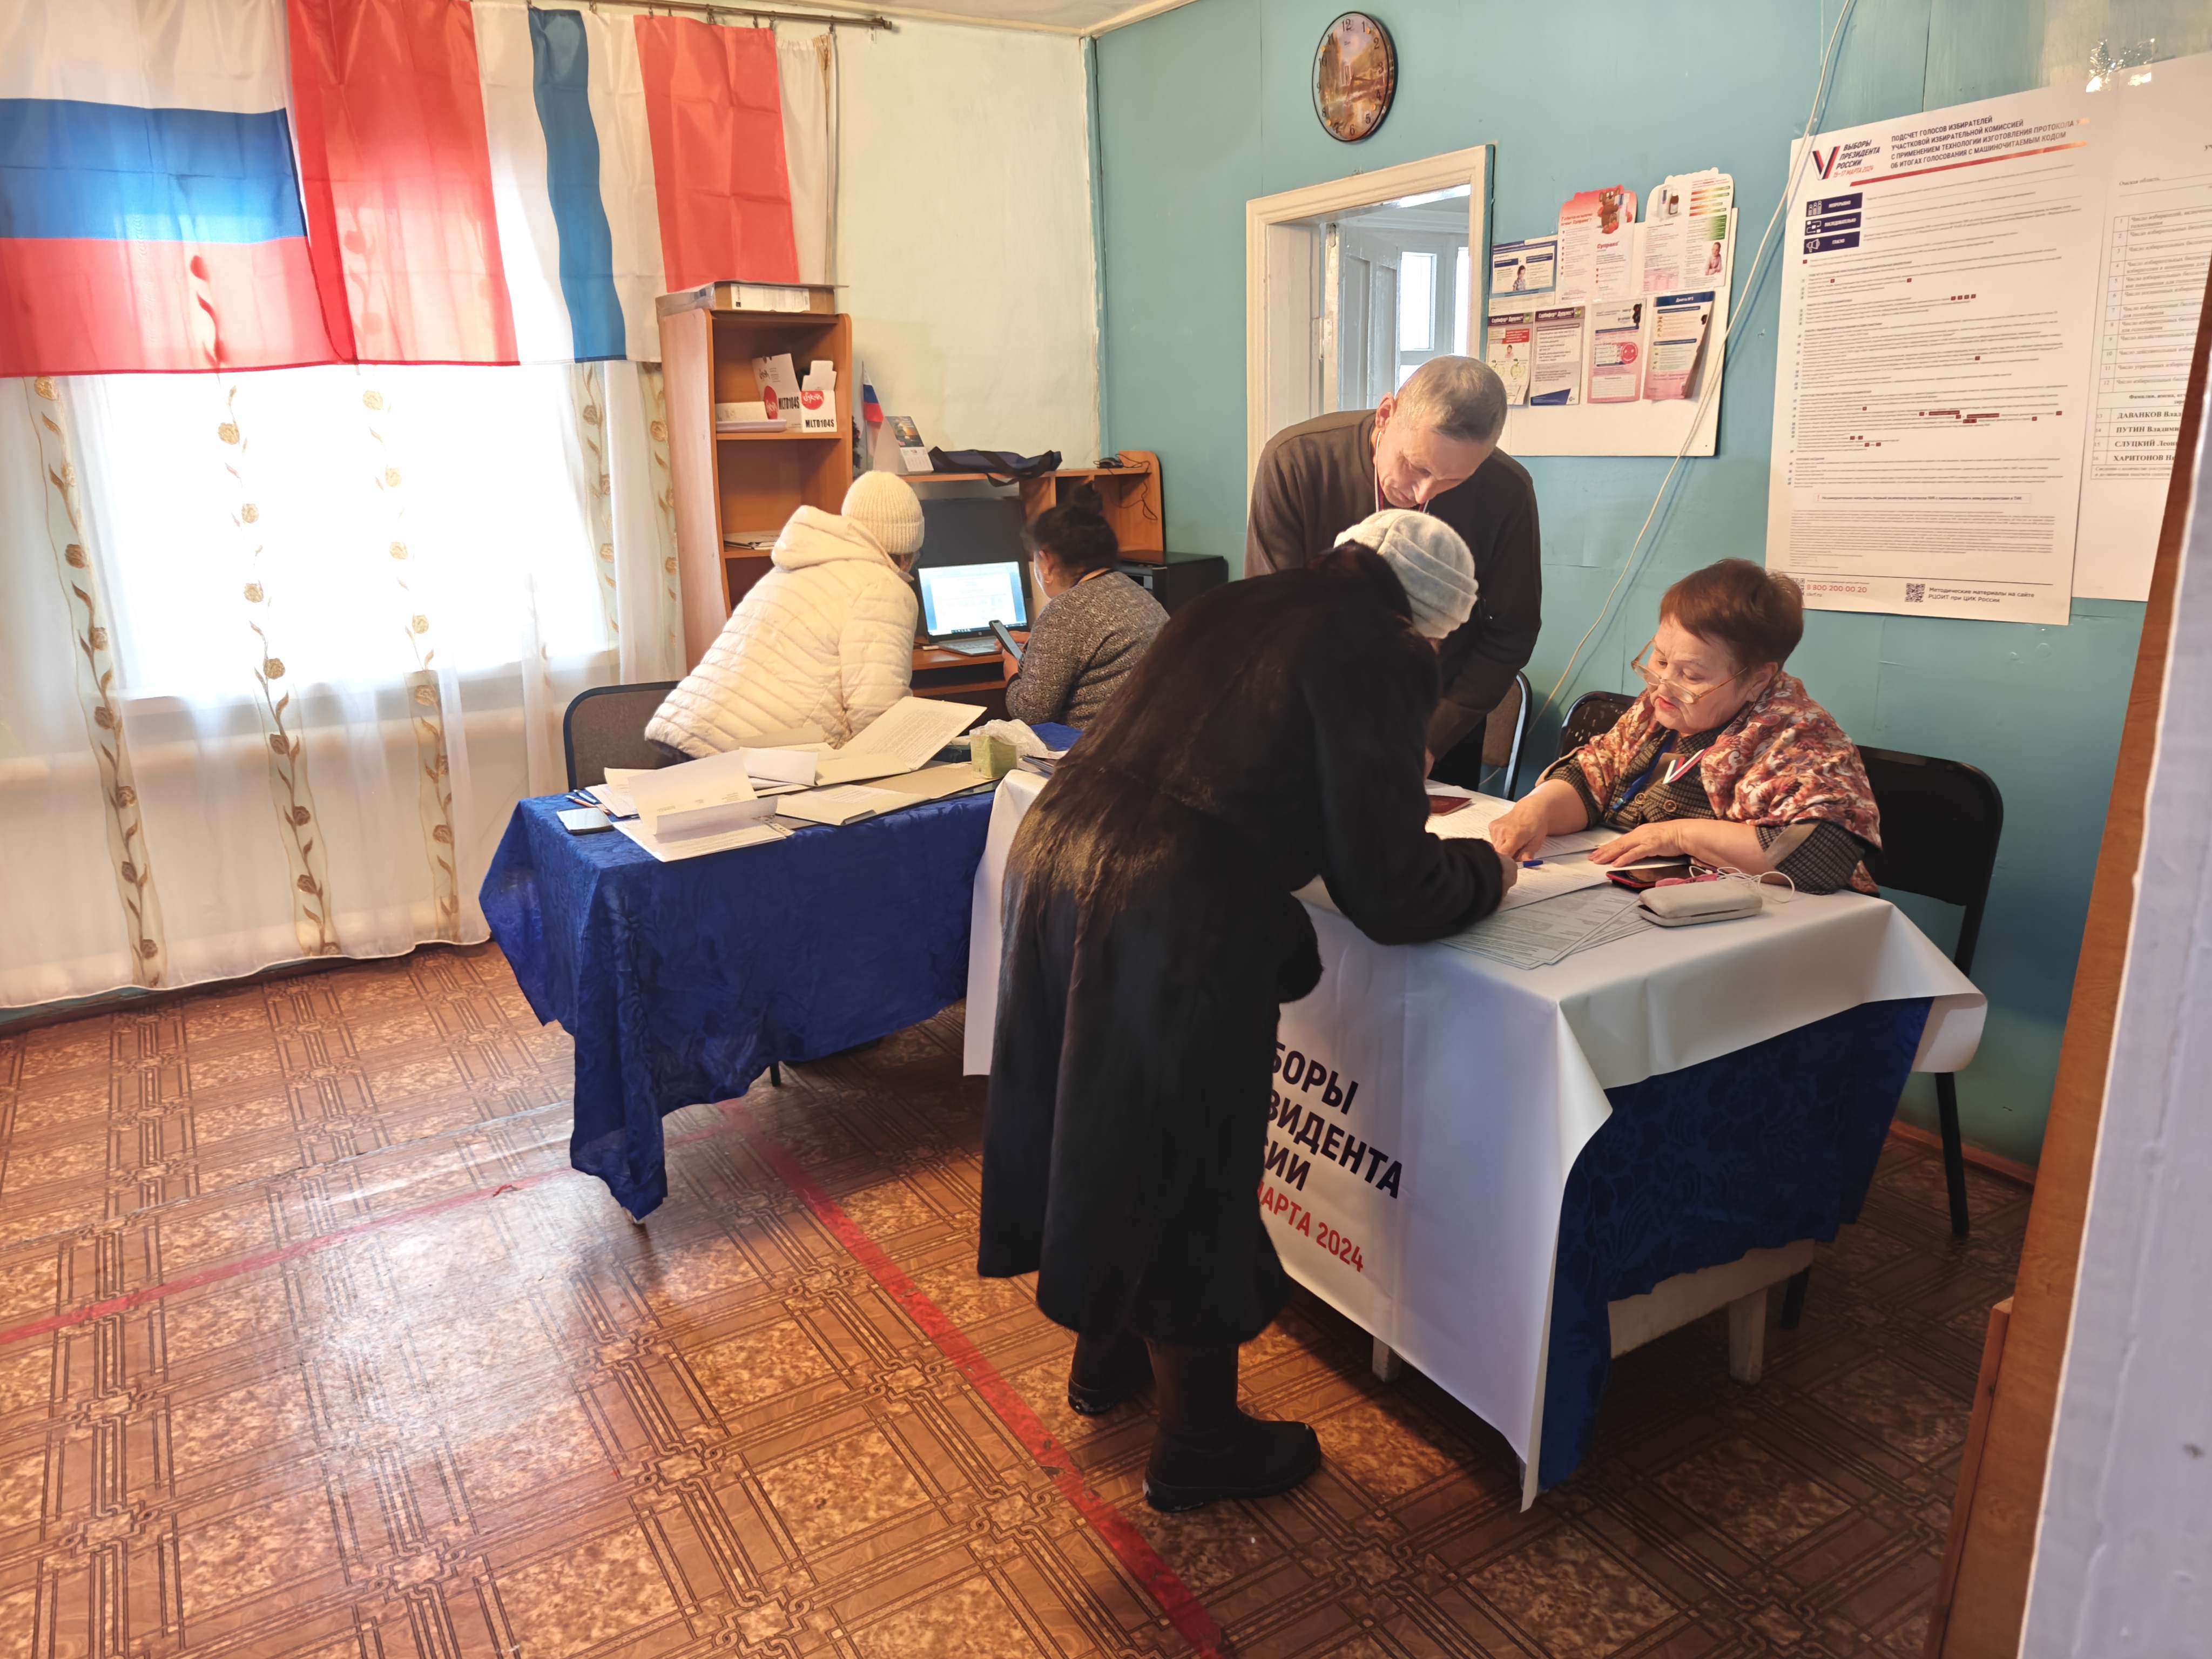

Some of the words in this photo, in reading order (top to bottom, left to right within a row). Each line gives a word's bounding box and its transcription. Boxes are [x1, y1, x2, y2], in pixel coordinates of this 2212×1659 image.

[1341, 18, 1352, 32] 12
[1361, 22, 1365, 32] 1
[1374, 37, 1380, 50] 2
[1378, 62, 1384, 74] 3
[1321, 106, 1327, 118] 8
[1365, 113, 1371, 125] 5
[1350, 125, 1355, 136] 6
[1891, 131, 1918, 142] ПОДСЧЕТ
[1919, 126, 1947, 137] ГОЛОСОВ
[1948, 115, 1993, 130] ИЗБИРАТЕЛЕЙ
[1891, 137, 1930, 151] УЧАСТКОВОЙ
[1931, 127, 1982, 144] ИЗБИРАТЕЛЬНОЙ
[1985, 119, 2024, 133] КОМИССИЕЙ
[1897, 145, 1940, 159] ПРИМЕНЕНИЕМ
[1942, 139, 1981, 152] ТЕХНОЛОГИИ
[1982, 128, 2032, 143] ИЗГОТОВЛЕНИЯ
[2034, 120, 2074, 133] ПРОТОКОЛА
[1843, 139, 1872, 151] ВЫБОРЫ
[1900, 158, 1922, 168] ИТОГАХ
[1923, 150, 1967, 164] ГОЛОСОВАНИЯ
[1974, 137, 2040, 154] МАШИНОЧИТАЕМЫМ
[2041, 131, 2066, 141] КОДОМ
[1839, 146, 1880, 161] ПРЕЗИДЕНТА
[1836, 159, 1863, 170] РОССИИ
[805, 419, 834, 428] MLTD104S
[2114, 439, 2155, 448] СЛУЦКИЙ
[1316, 1222, 1364, 1272] 2024
